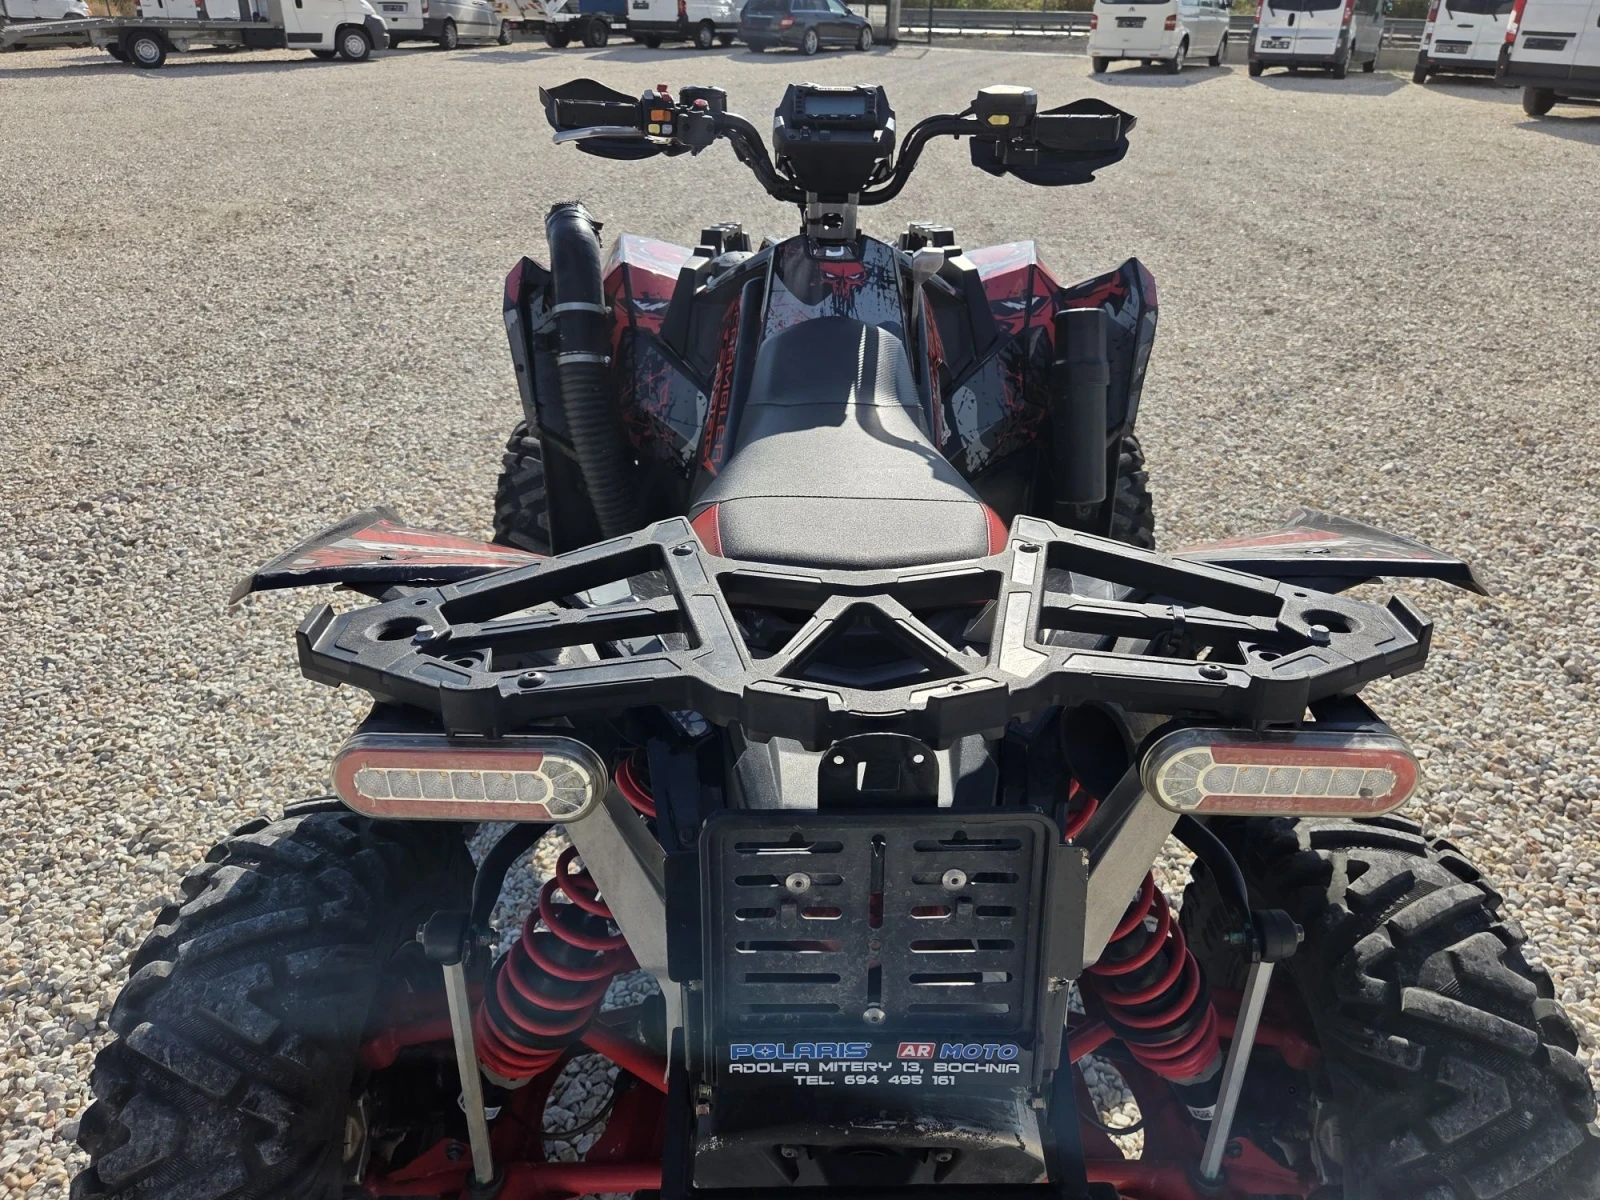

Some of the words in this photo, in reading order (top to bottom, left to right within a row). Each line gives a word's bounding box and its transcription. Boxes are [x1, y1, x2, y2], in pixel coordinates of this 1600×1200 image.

[730, 1042, 871, 1060] POLARIS
[900, 1044, 932, 1057] AR
[939, 1042, 1019, 1060] MOTO
[728, 1062, 810, 1073] ADOLFA
[819, 1062, 893, 1072] MITERY
[901, 1062, 925, 1074] 13,
[933, 1062, 1020, 1073] BOCHNIA
[793, 1075, 835, 1085] TEL.
[844, 1074, 879, 1085] 694
[888, 1075, 923, 1085] 495
[931, 1075, 955, 1086] 161
